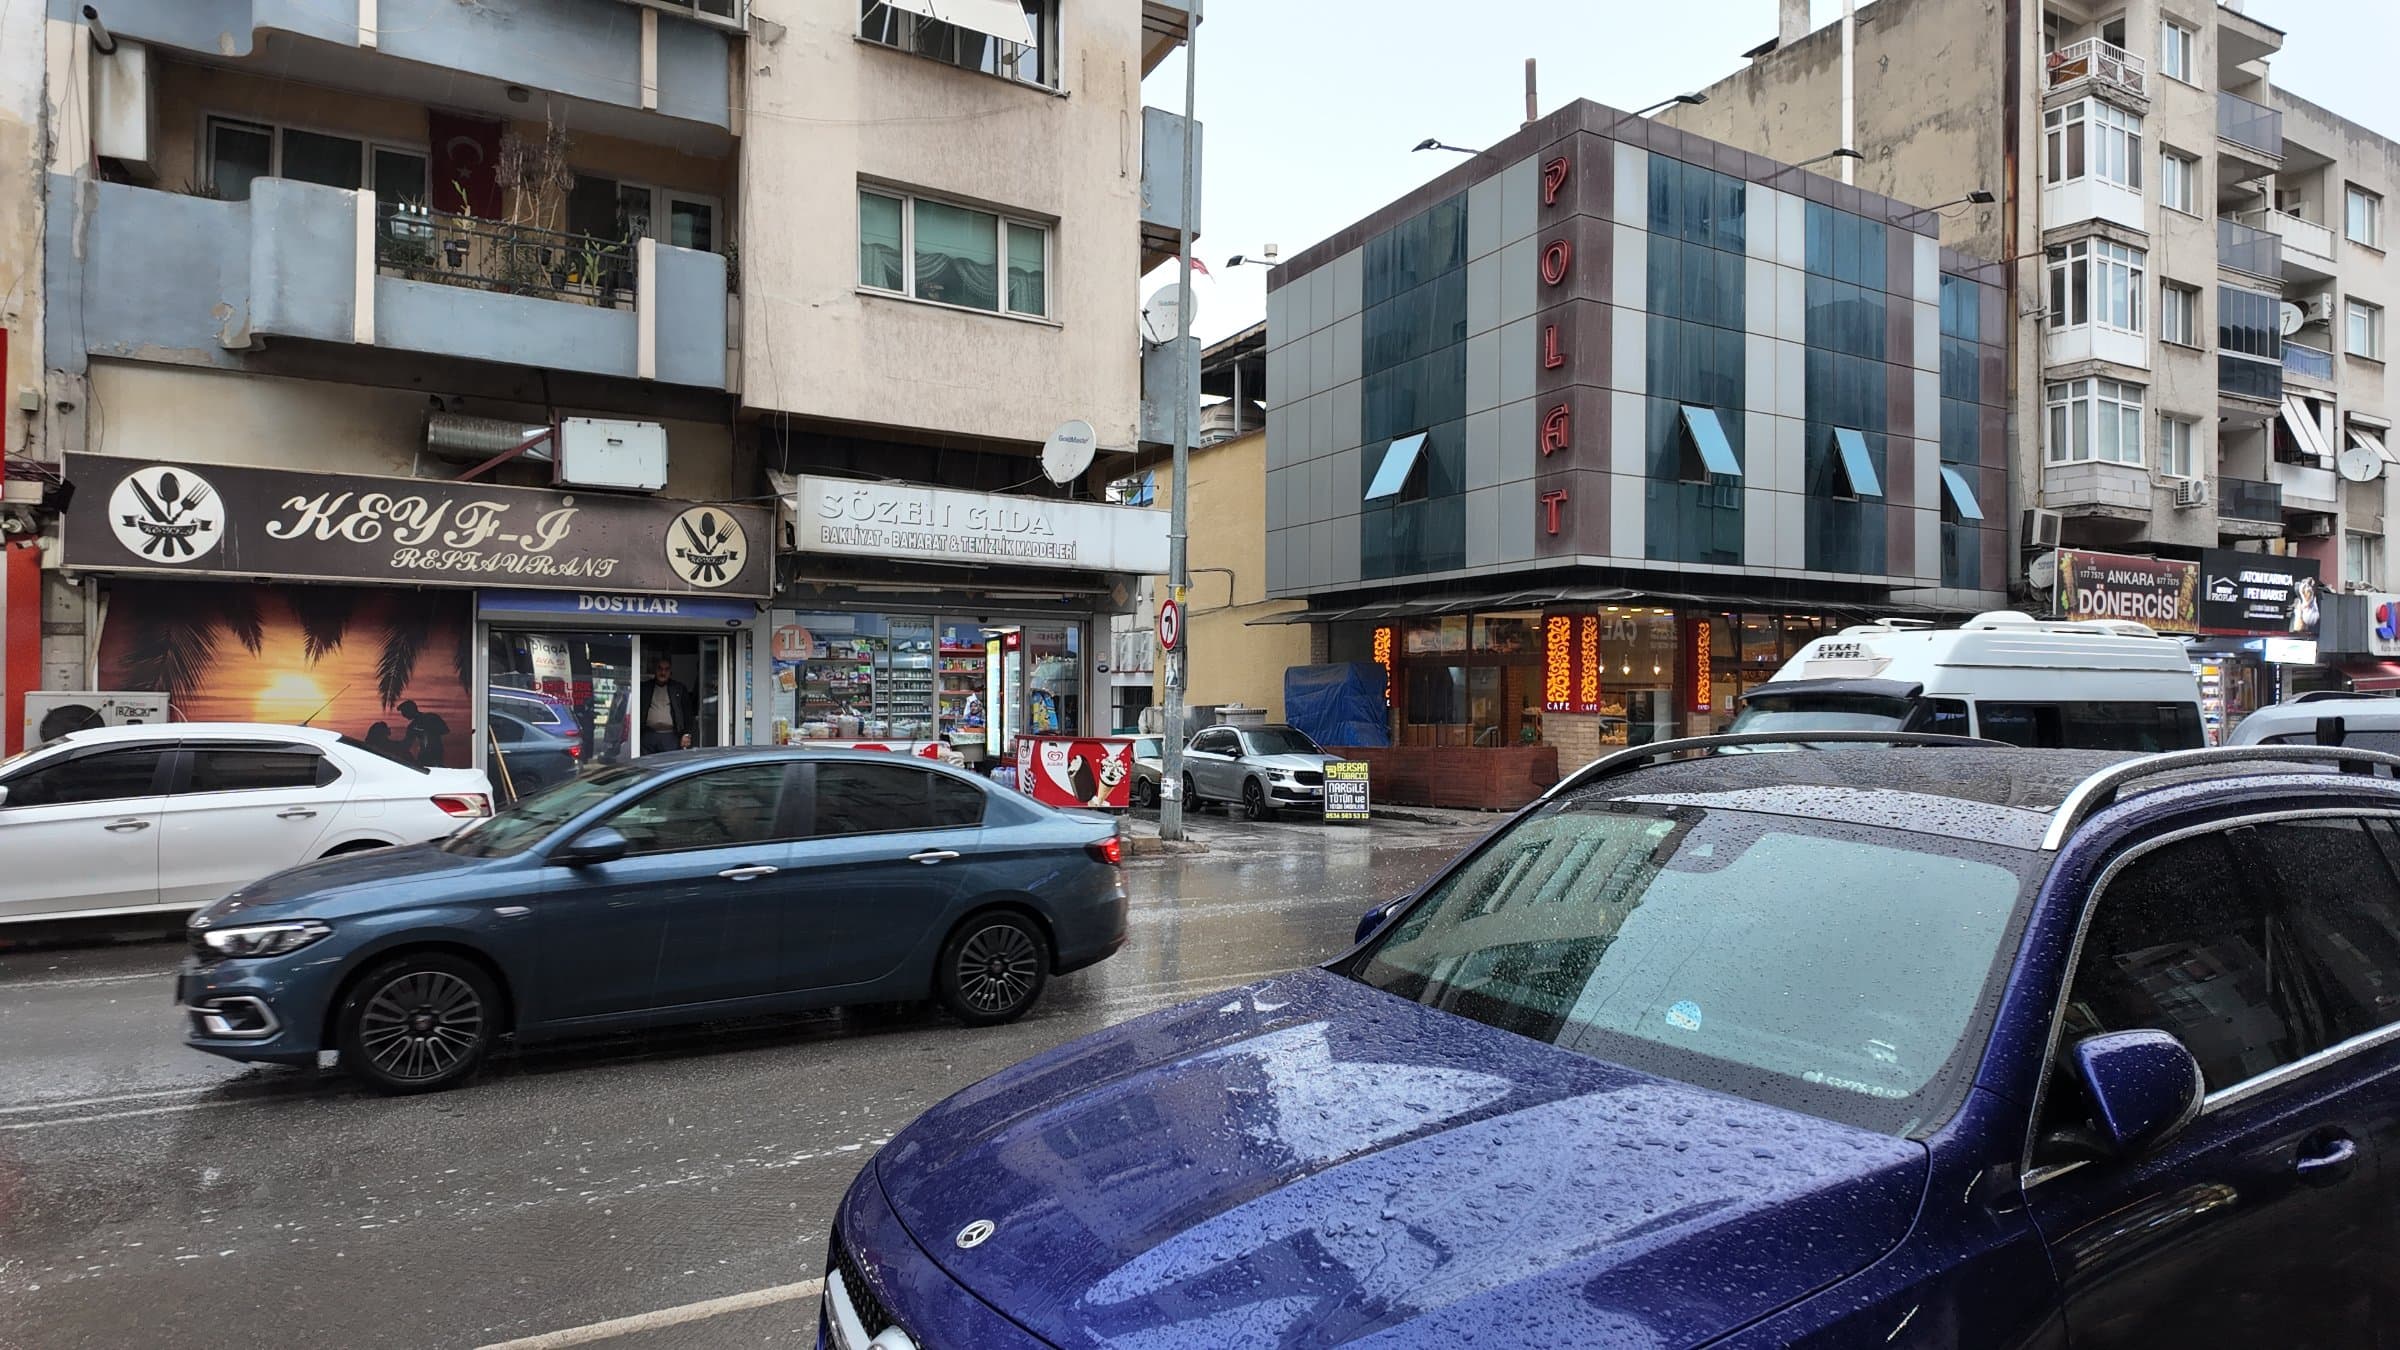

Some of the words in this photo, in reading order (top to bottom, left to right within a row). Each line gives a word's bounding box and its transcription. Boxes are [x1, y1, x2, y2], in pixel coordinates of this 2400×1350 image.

[1540, 156, 1573, 535] POLAT
[265, 491, 580, 553] KEYF-İ
[815, 489, 952, 528] SÖZEN
[964, 507, 1056, 536] GIDA
[820, 523, 883, 546] BAKLİYAT
[891, 530, 948, 551] BAHARAT
[960, 533, 1015, 557] TEMİZLİK
[1015, 538, 1077, 561] MADDELERİ
[390, 547, 620, 579] RESTAURANT
[2107, 569, 2155, 587] ANKARA
[577, 595, 680, 614] DOSTLAR
[2078, 583, 2180, 620] DÖNERCİSİ
[779, 629, 806, 651] TL
[1547, 702, 1570, 711] CAFE
[1337, 763, 1368, 772] BERSAN
[1338, 772, 1368, 780] TOBACCO
